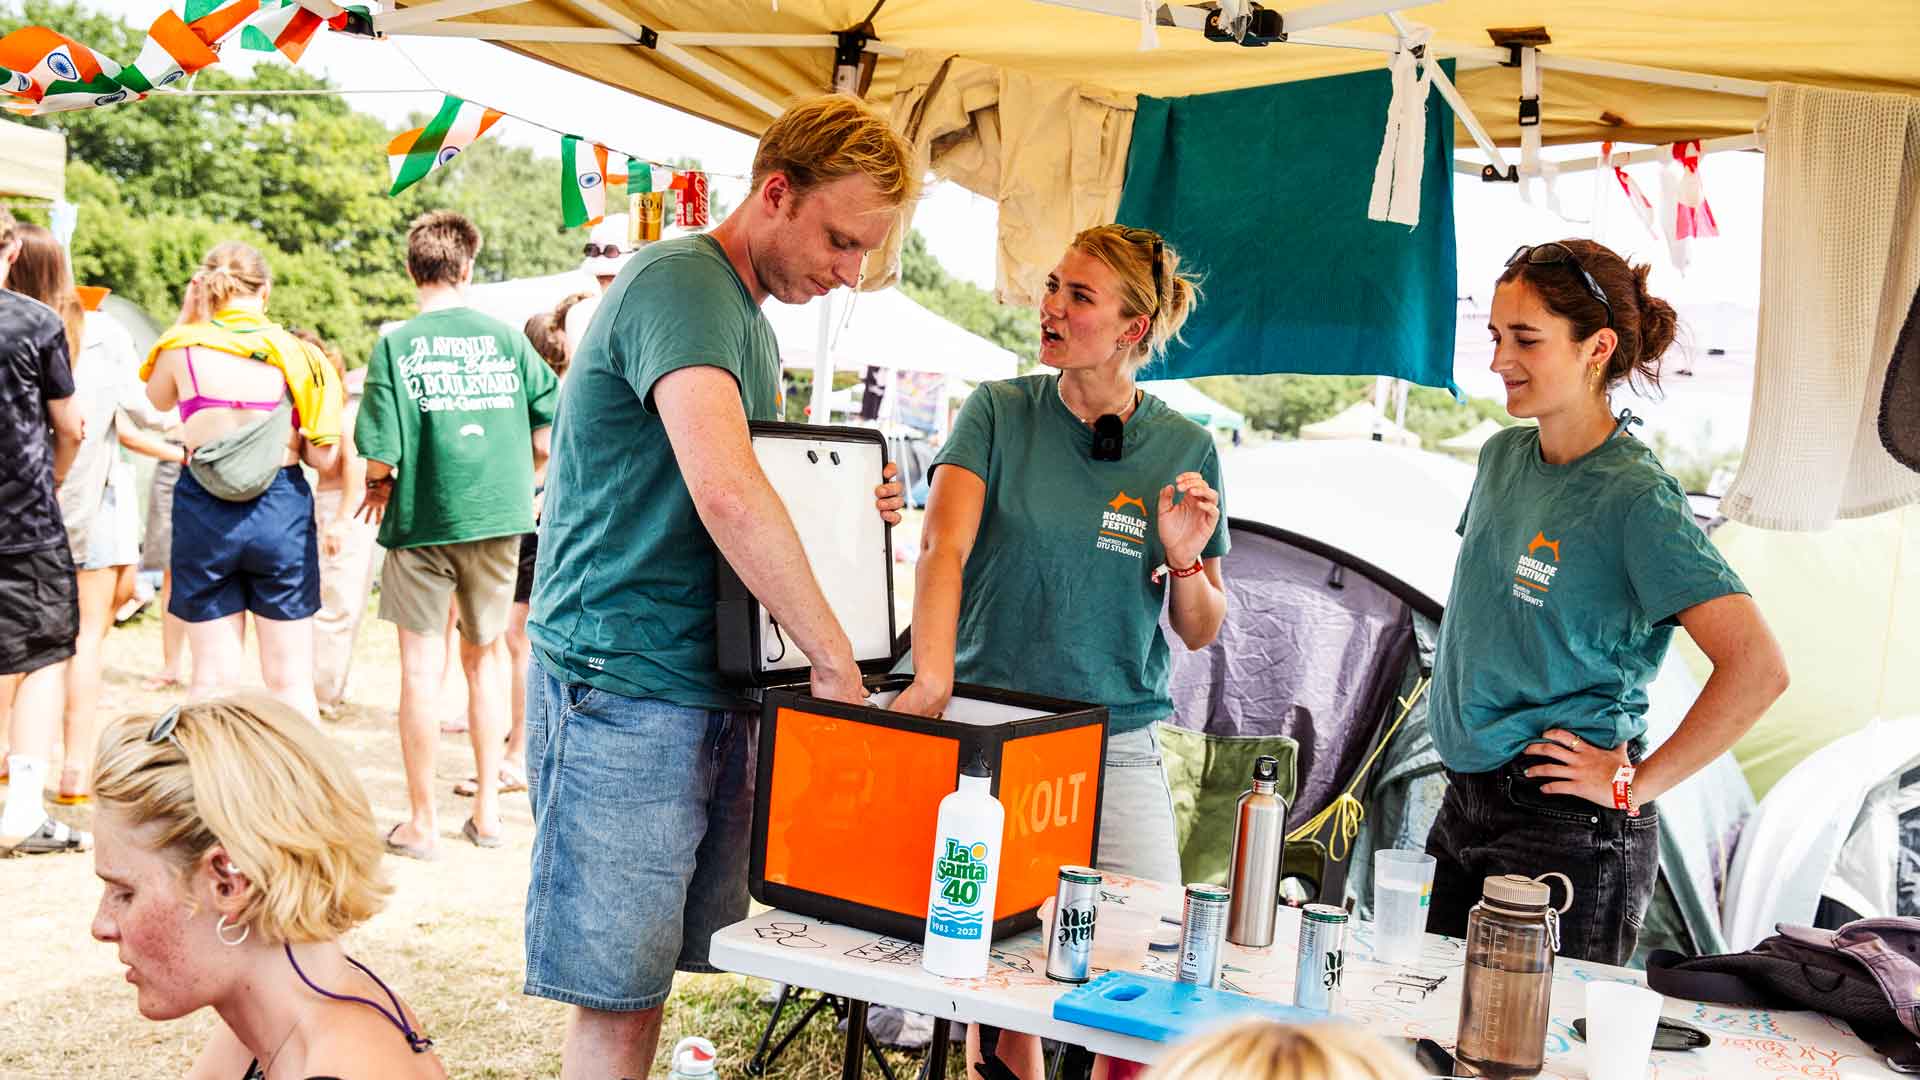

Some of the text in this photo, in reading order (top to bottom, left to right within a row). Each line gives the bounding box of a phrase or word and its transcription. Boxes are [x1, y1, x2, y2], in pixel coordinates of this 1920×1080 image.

[432, 335, 498, 357] AVENUE
[421, 372, 520, 395] BOULEVARD
[419, 394, 515, 412] Saint-Germain
[1101, 519, 1145, 538] FESTIVAL
[1102, 511, 1147, 531] ROSKILDE
[1110, 544, 1143, 559] STUDENTS
[1515, 565, 1550, 585] FESTIVAL
[1008, 772, 1087, 840] KOLT
[946, 840, 970, 863] La
[942, 879, 979, 905] 40
[932, 920, 949, 933] 1983
[956, 926, 978, 936] 2023
